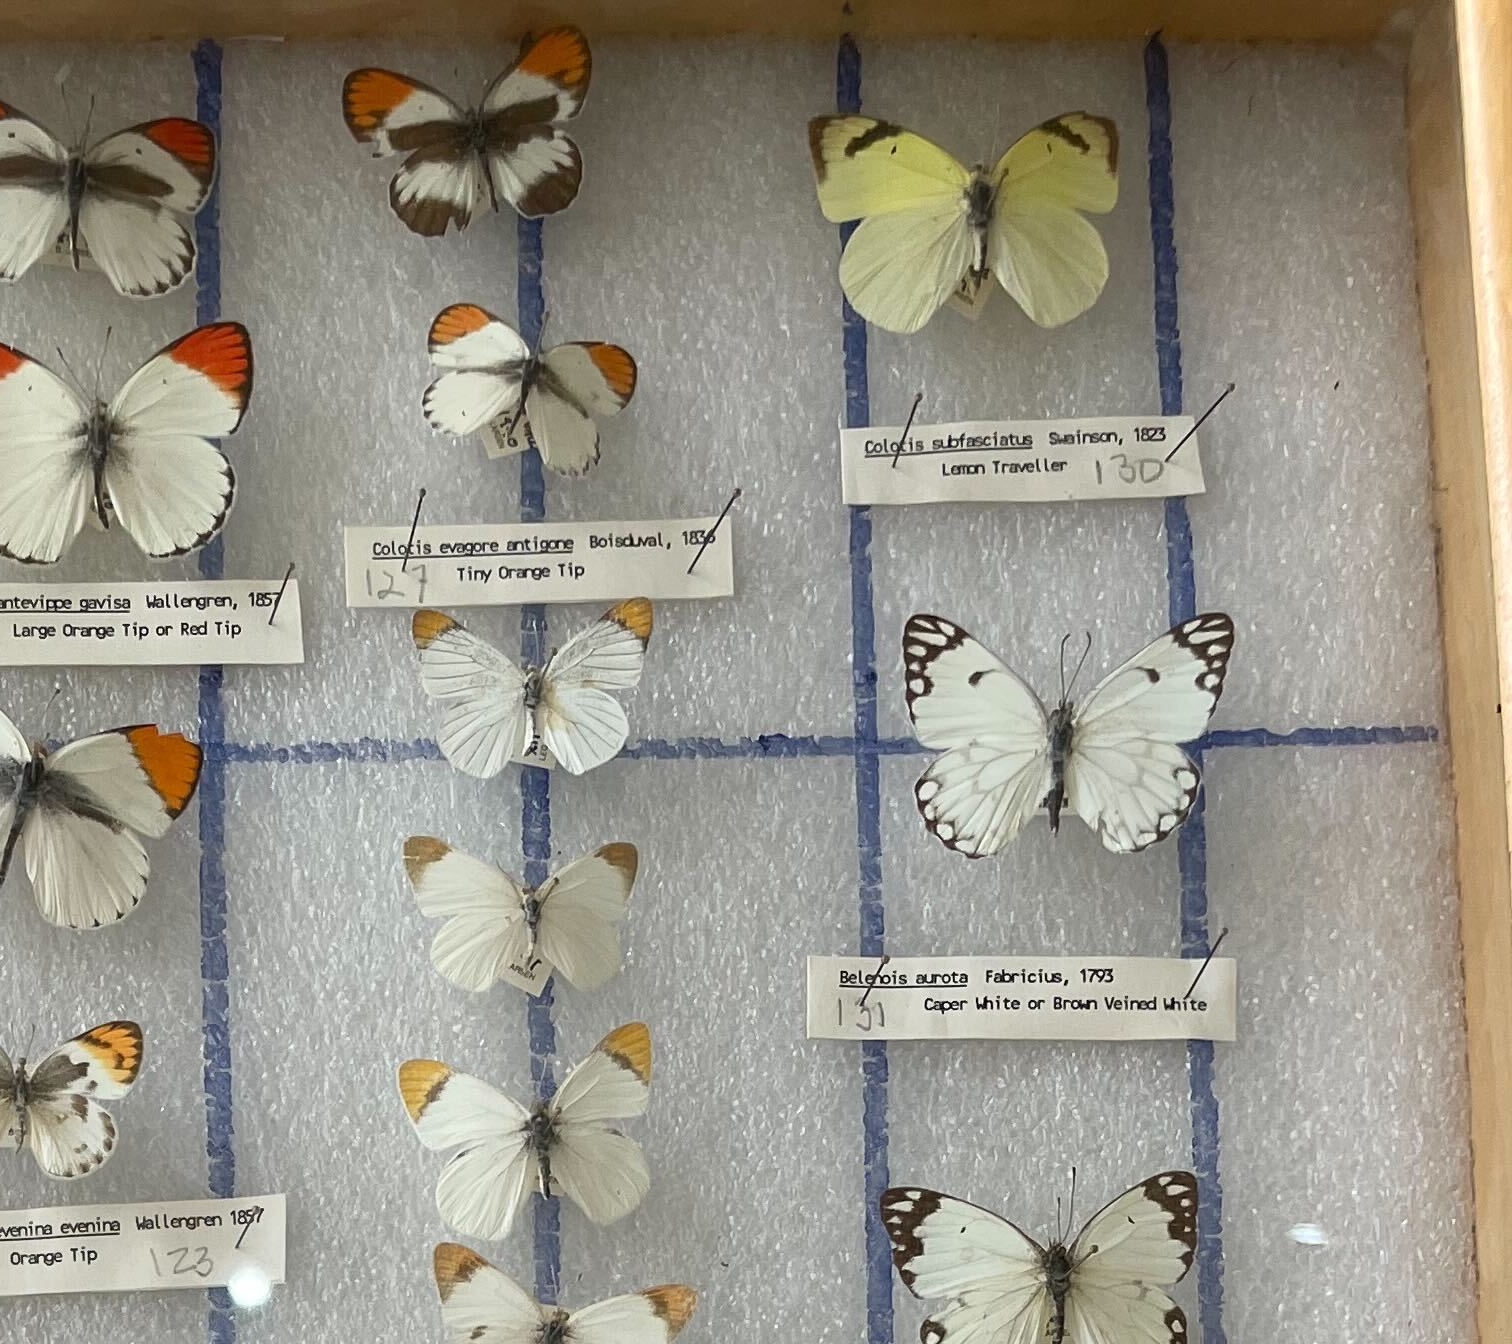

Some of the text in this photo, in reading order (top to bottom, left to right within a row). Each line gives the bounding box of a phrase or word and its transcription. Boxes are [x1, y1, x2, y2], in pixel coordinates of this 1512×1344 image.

[865, 428, 1166, 454] Colotis subfasciatus Swainson, 1823
[942, 460, 1067, 475] Lemon Traveller
[457, 563, 585, 582] Tiny Orange Tip
[13, 621, 242, 639] Large Orange Tip or Red Tip
[925, 997, 1207, 1014] Caper White or Brown Veined White
[11, 1248, 98, 1266] Orange Tip
